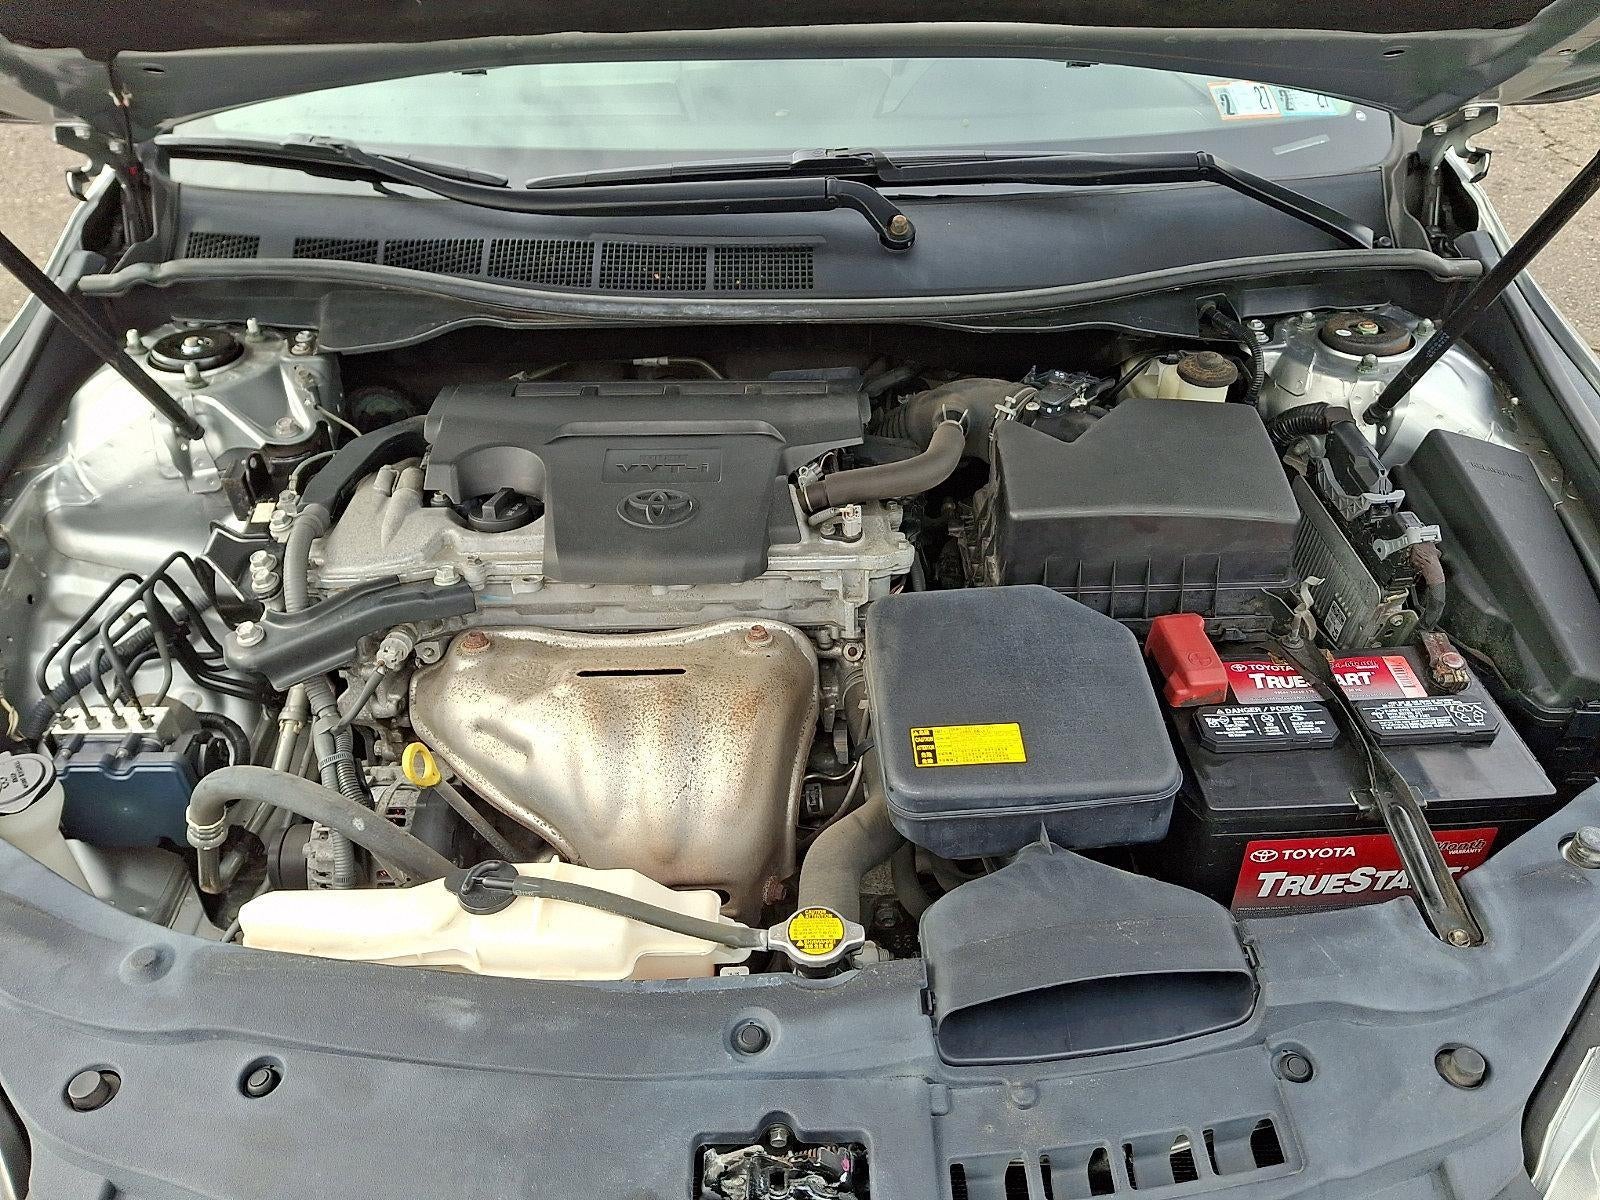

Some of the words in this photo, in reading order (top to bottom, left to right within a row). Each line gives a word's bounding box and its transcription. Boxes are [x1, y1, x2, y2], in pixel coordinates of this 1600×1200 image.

[1248, 664, 1295, 672] TOYOTA
[1225, 706, 1261, 714] DANGER
[1270, 704, 1305, 712] POISON
[1282, 846, 1357, 860] TOYOTA
[1256, 865, 1462, 898] TRUESTA
